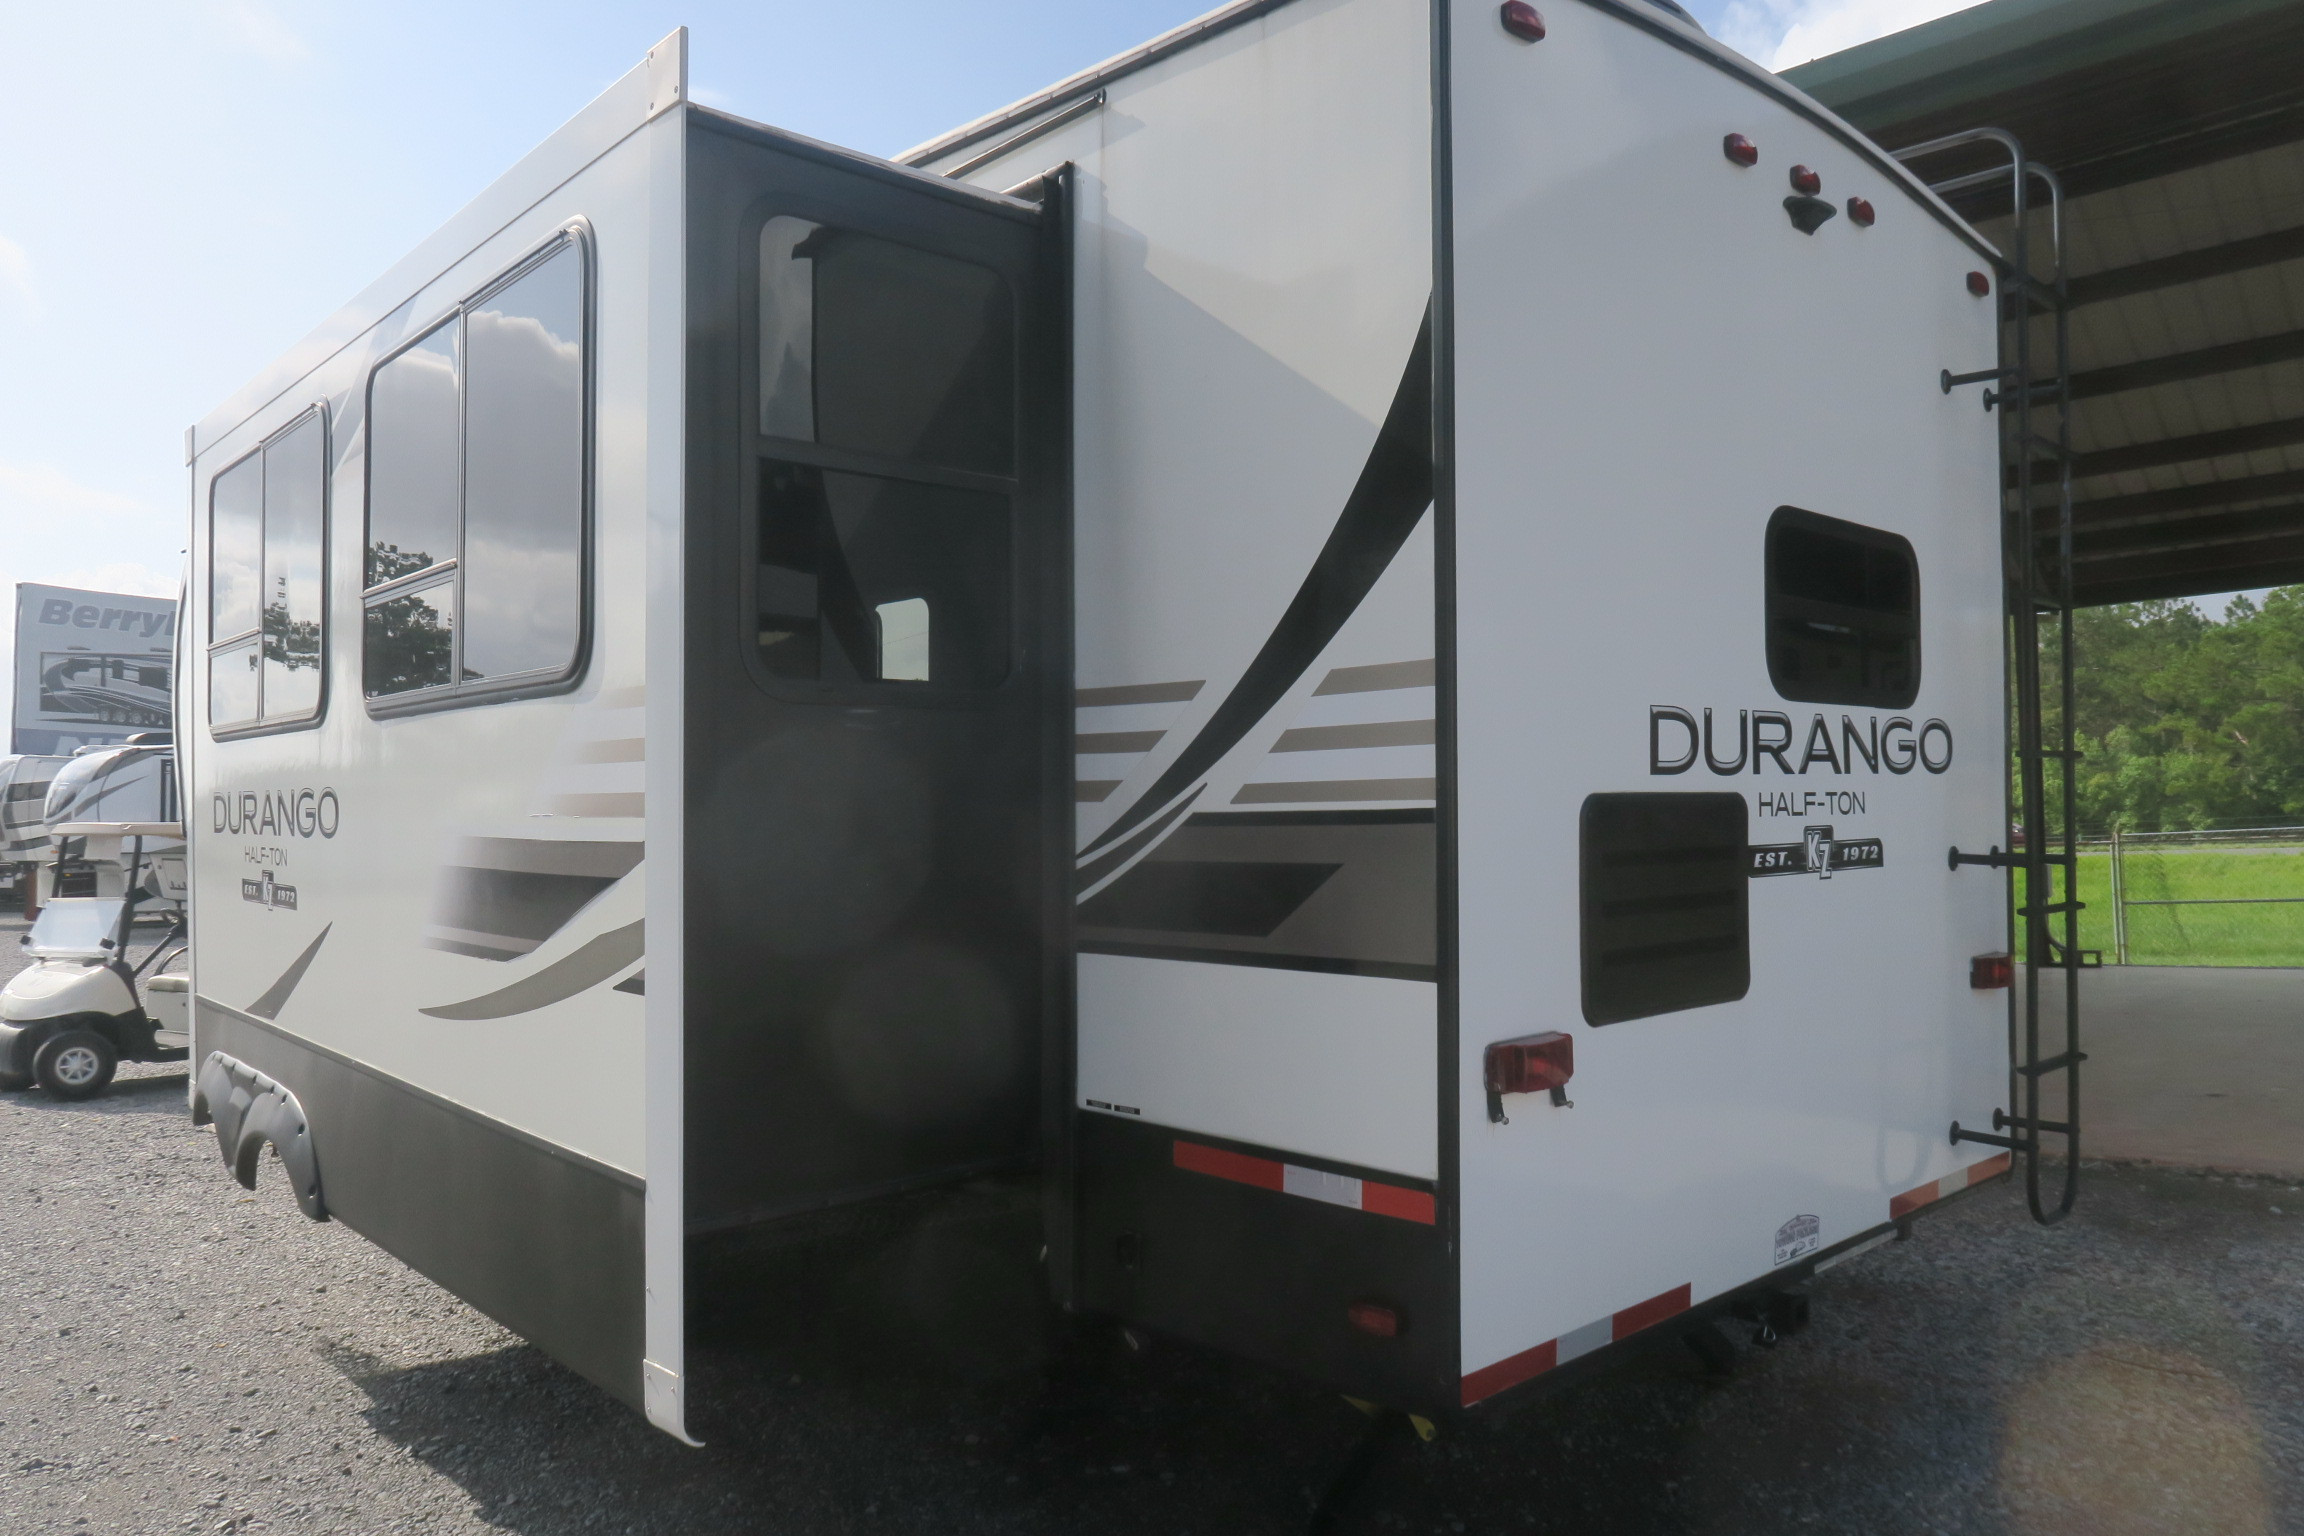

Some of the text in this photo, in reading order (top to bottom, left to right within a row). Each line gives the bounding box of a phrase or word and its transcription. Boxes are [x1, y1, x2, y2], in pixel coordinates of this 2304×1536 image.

[1650, 704, 1953, 776] DURANGO
[213, 786, 340, 839] DURANGO
[1758, 791, 1866, 817] HALF-TON
[244, 845, 288, 867] HALF-TON
[1753, 830, 1879, 880] EST. KZ 1972
[244, 884, 259, 896] EST.
[277, 889, 295, 903] 1972
